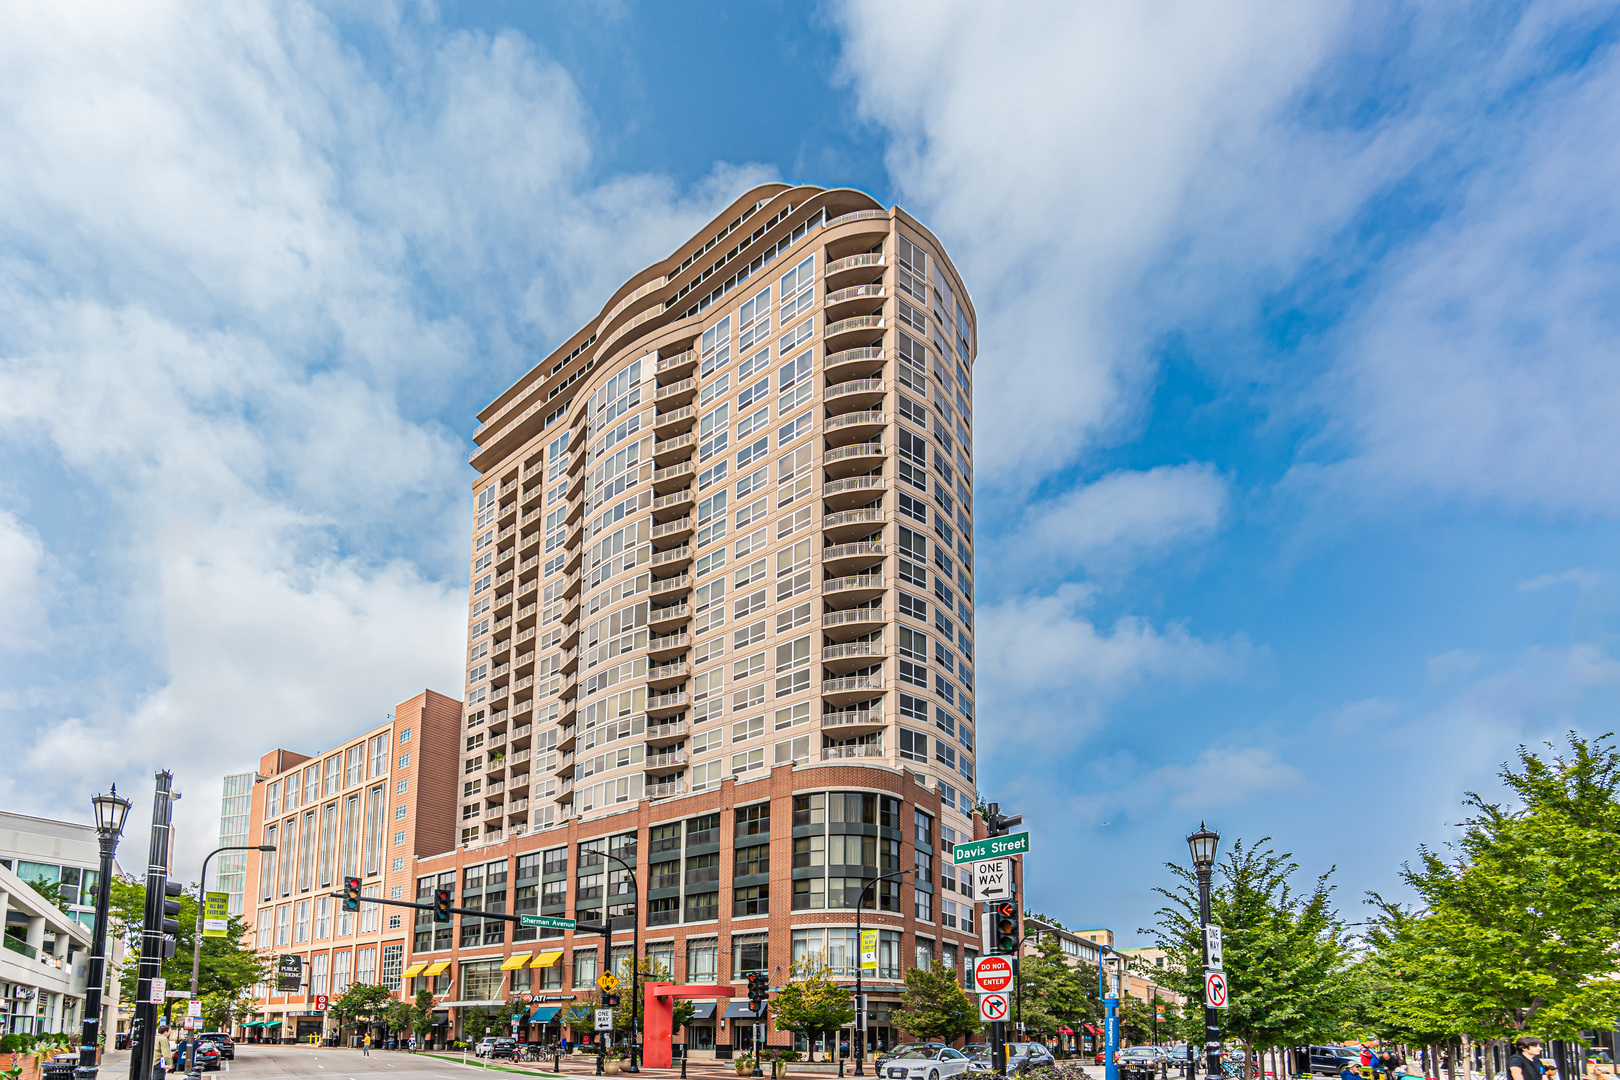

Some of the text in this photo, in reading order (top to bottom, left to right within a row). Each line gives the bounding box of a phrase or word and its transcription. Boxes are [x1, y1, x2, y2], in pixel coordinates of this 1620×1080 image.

[956, 837, 1026, 860] Davis Street
[979, 862, 1003, 874] ONE
[979, 873, 1004, 885] WAY
[522, 916, 575, 928] Sherman Avenue
[1208, 928, 1219, 940] ONE
[1209, 940, 1220, 951] WAY
[983, 978, 1005, 986] ENTER
